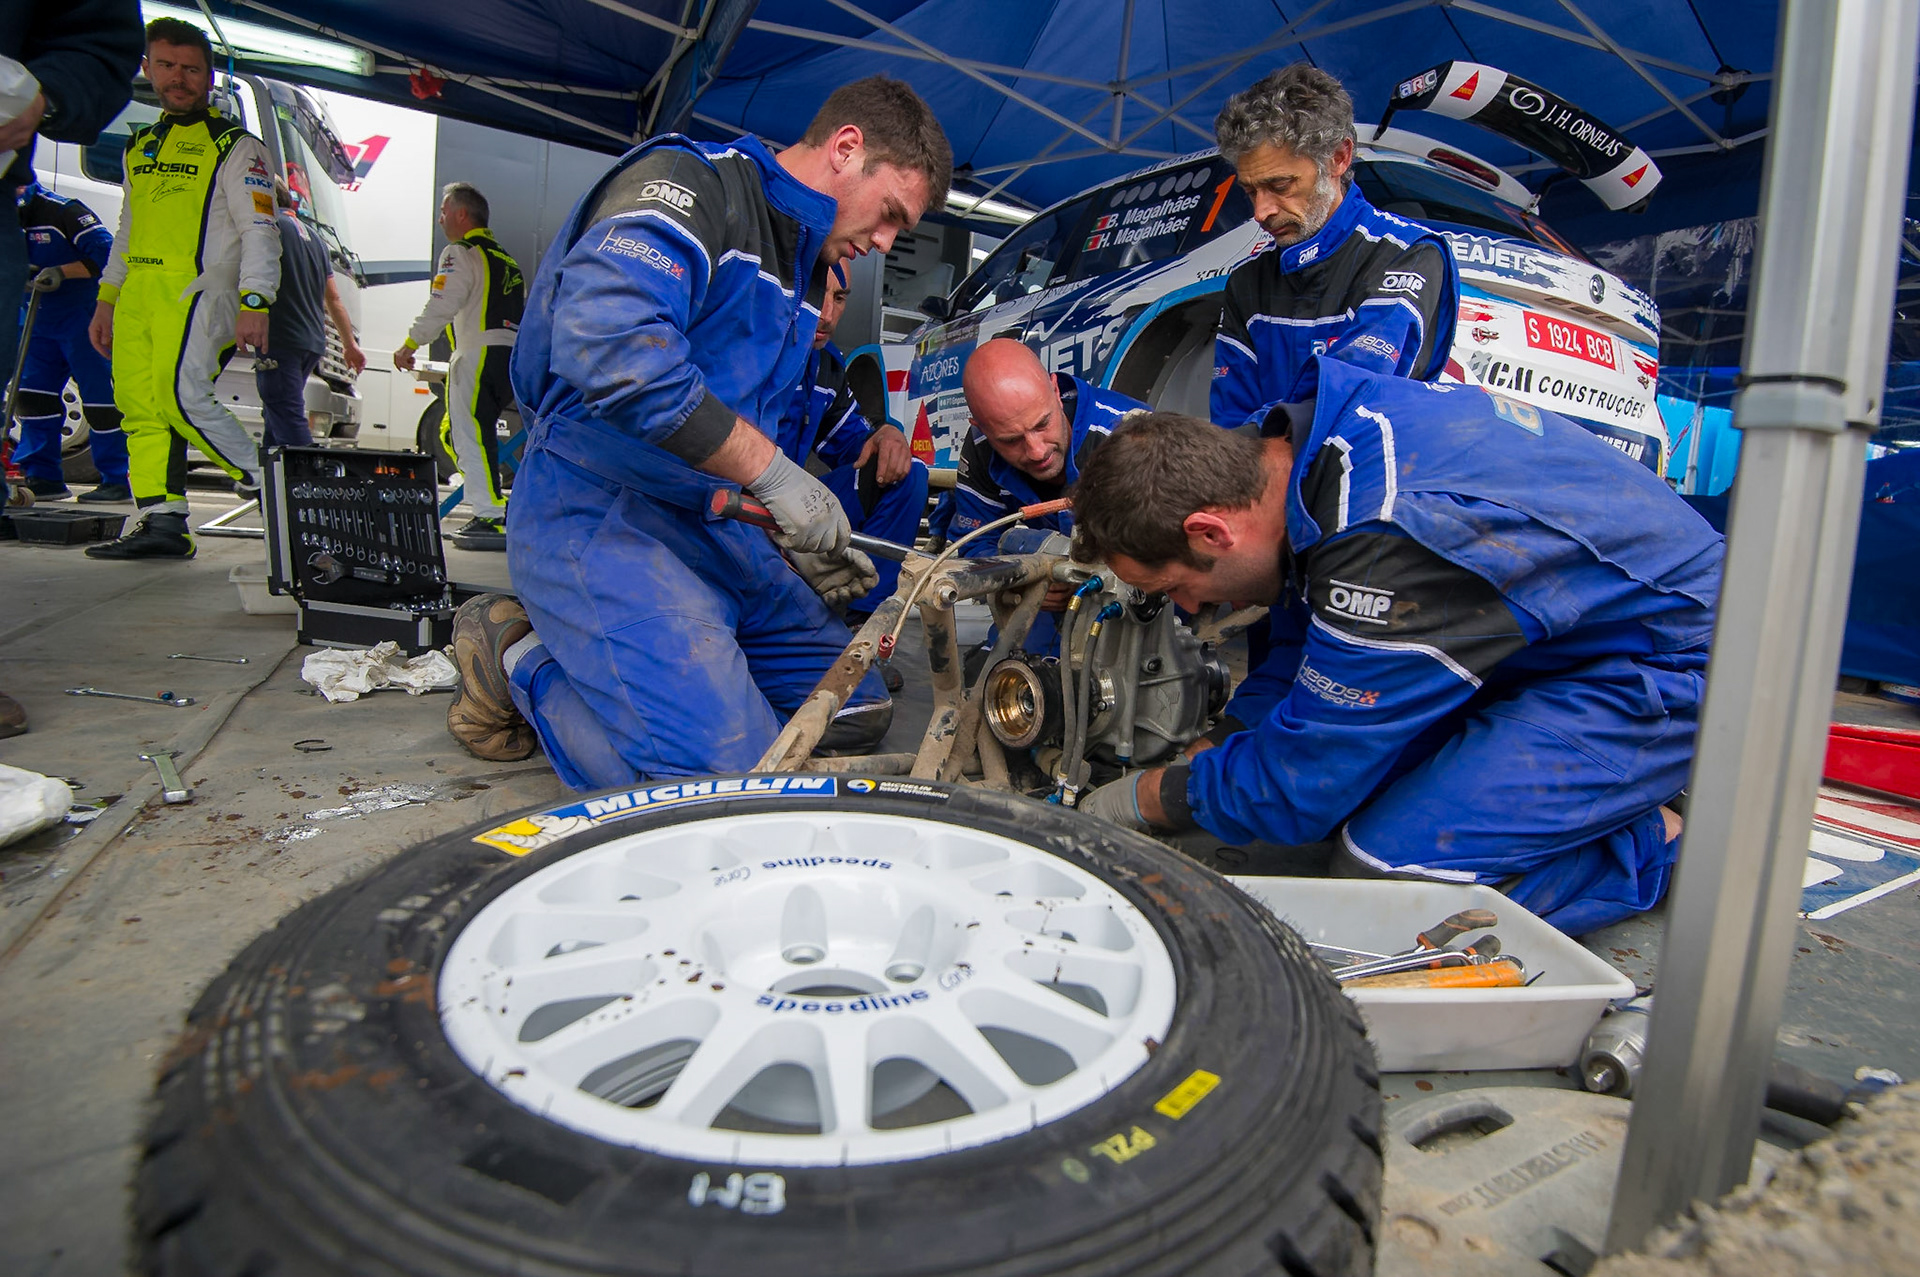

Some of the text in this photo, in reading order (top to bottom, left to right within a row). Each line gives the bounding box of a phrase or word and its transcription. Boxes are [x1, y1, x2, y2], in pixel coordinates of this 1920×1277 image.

[1540, 104, 1622, 157] J. H. ORNELAS
[641, 184, 694, 208] OMP
[1200, 174, 1237, 233] 1
[1106, 195, 1201, 229] B. Magalhães
[1098, 215, 1191, 249] H. Magalhães
[1299, 246, 1319, 265] OMP
[1450, 240, 1540, 276] EAJETS
[1382, 275, 1424, 291] OMP
[1528, 317, 1613, 365] S 1924 BCB
[920, 356, 960, 385] AZORES
[1538, 376, 1646, 419] CONSTRUÇÕES
[1596, 434, 1645, 462] ELIN
[1329, 587, 1391, 618] OMP
[585, 775, 829, 818] MICHELIN
[880, 781, 933, 792] MICHELIN
[713, 865, 752, 888] Corse
[761, 855, 894, 872] speedline
[756, 988, 929, 1013] speedline
